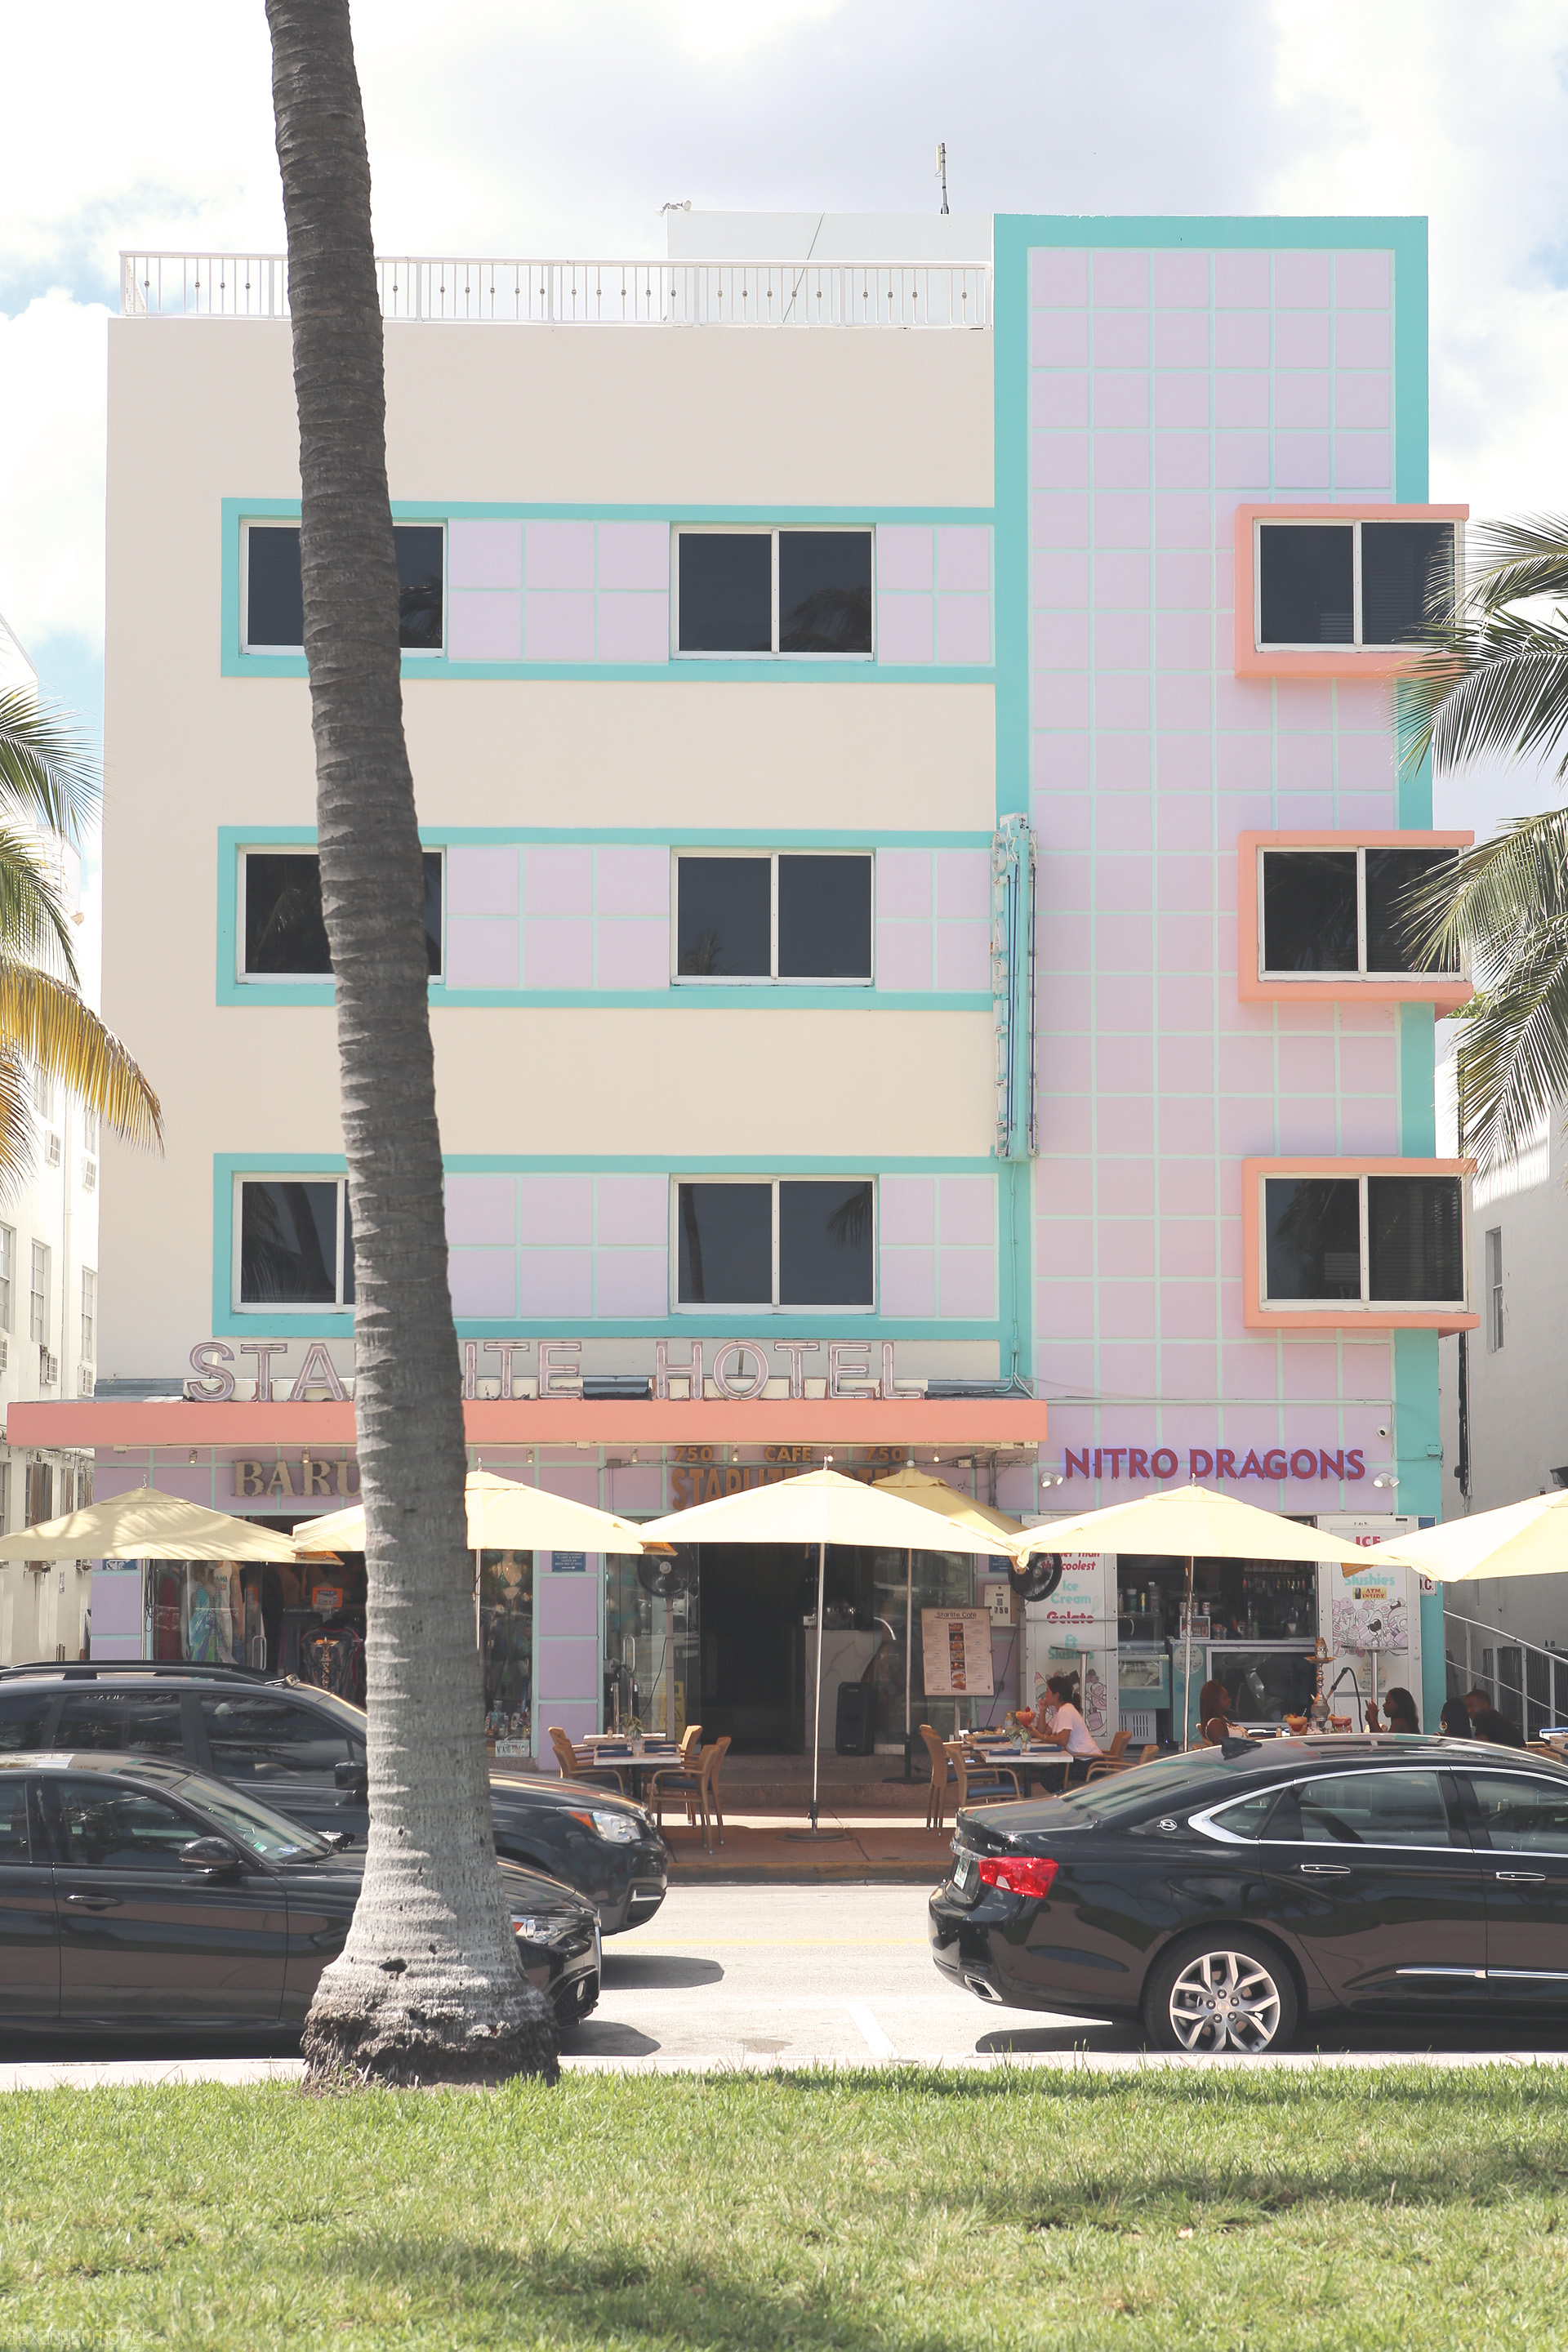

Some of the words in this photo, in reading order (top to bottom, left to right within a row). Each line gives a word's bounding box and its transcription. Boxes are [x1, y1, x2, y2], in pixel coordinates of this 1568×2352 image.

[187, 1340, 583, 1402] STAITE
[656, 1339, 924, 1401] HOTEL
[674, 1446, 713, 1462] 750
[764, 1446, 812, 1462] CAFE
[864, 1446, 904, 1462] 750
[1065, 1448, 1178, 1480] NITRO
[1189, 1448, 1365, 1480] DRAGONS
[671, 1468, 798, 1511] STAR
[1062, 1560, 1096, 1570] coolest
[1062, 1580, 1079, 1591] Ice
[1050, 1592, 1092, 1604] Cream
[1046, 1611, 1094, 1624] Gelato
[1048, 1648, 1094, 1659] Slushs
